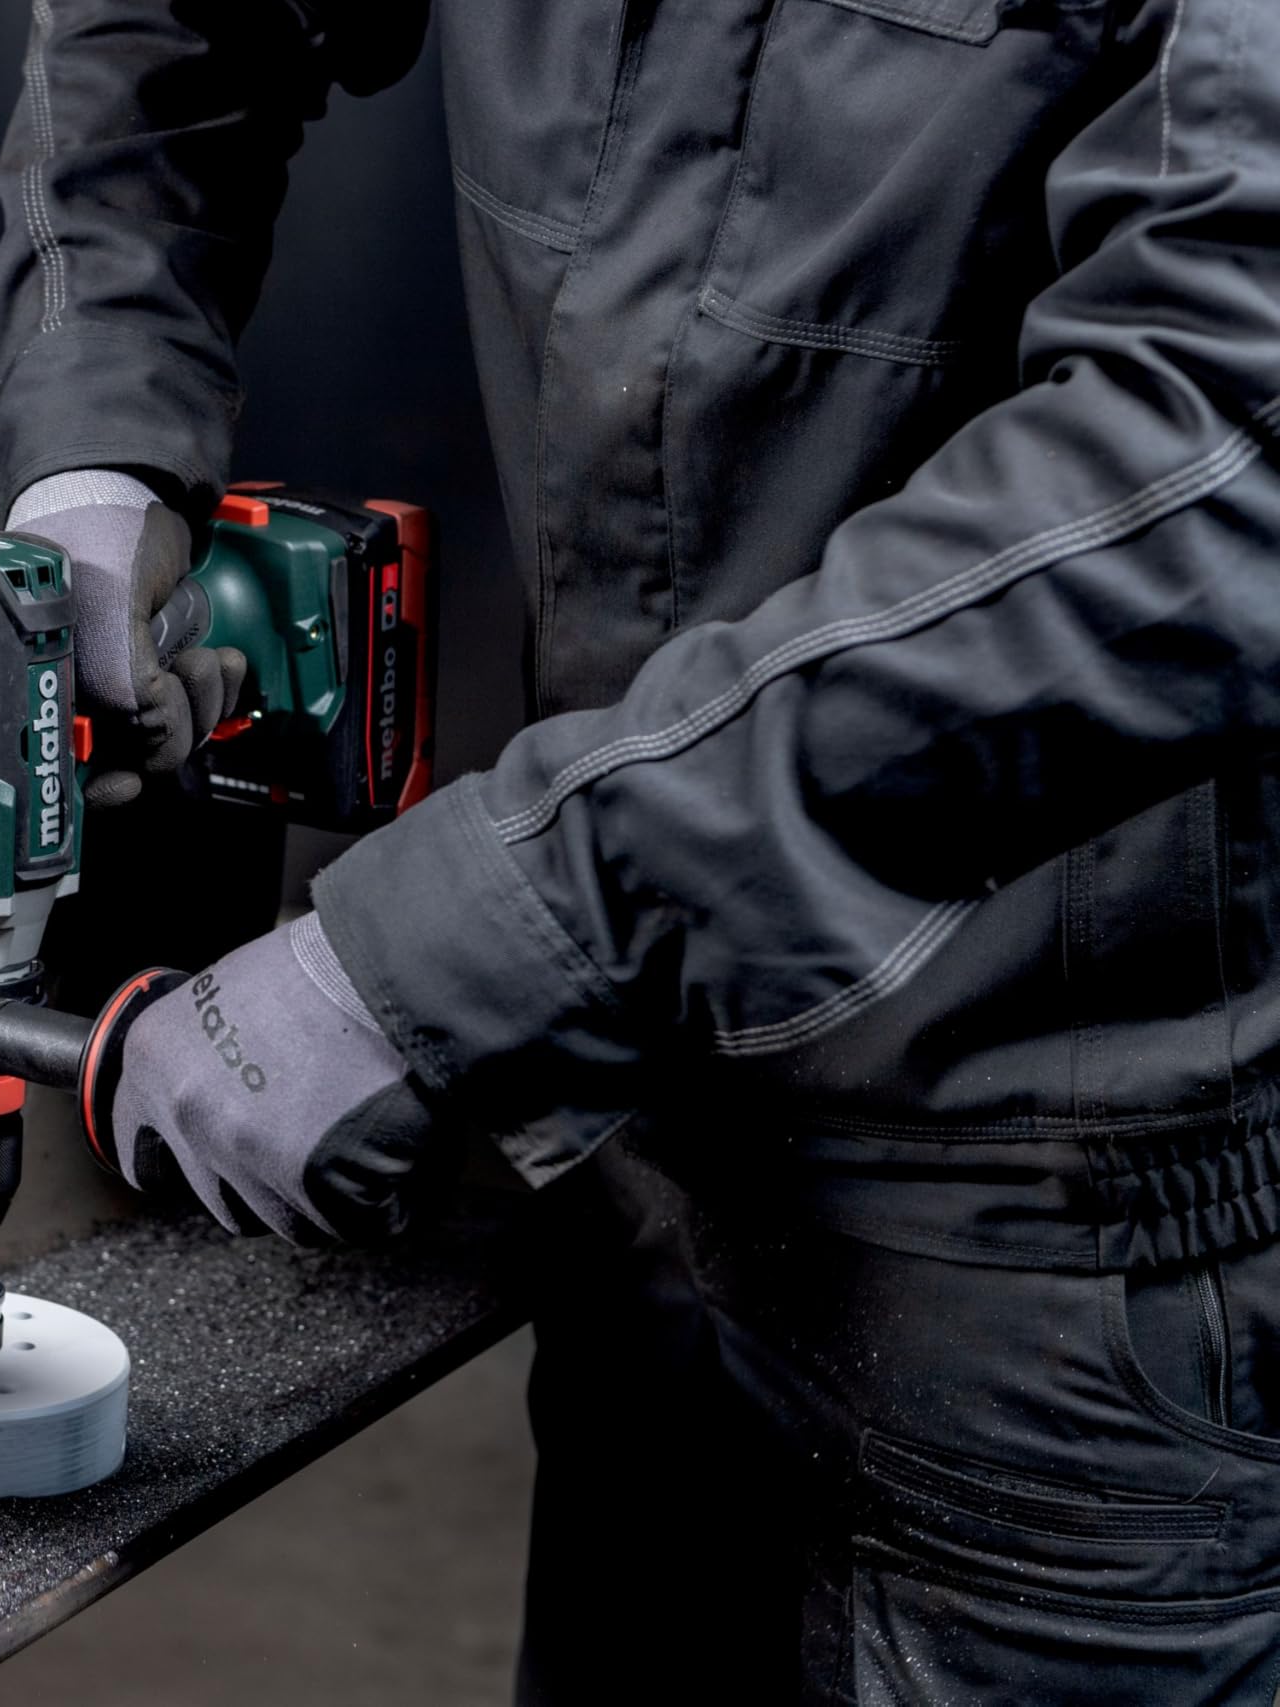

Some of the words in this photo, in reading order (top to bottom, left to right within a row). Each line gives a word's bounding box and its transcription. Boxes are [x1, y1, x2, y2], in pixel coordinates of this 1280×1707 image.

[32, 669, 61, 848] metabo
[380, 646, 397, 781] metabo
[192, 972, 267, 1094] etabo
